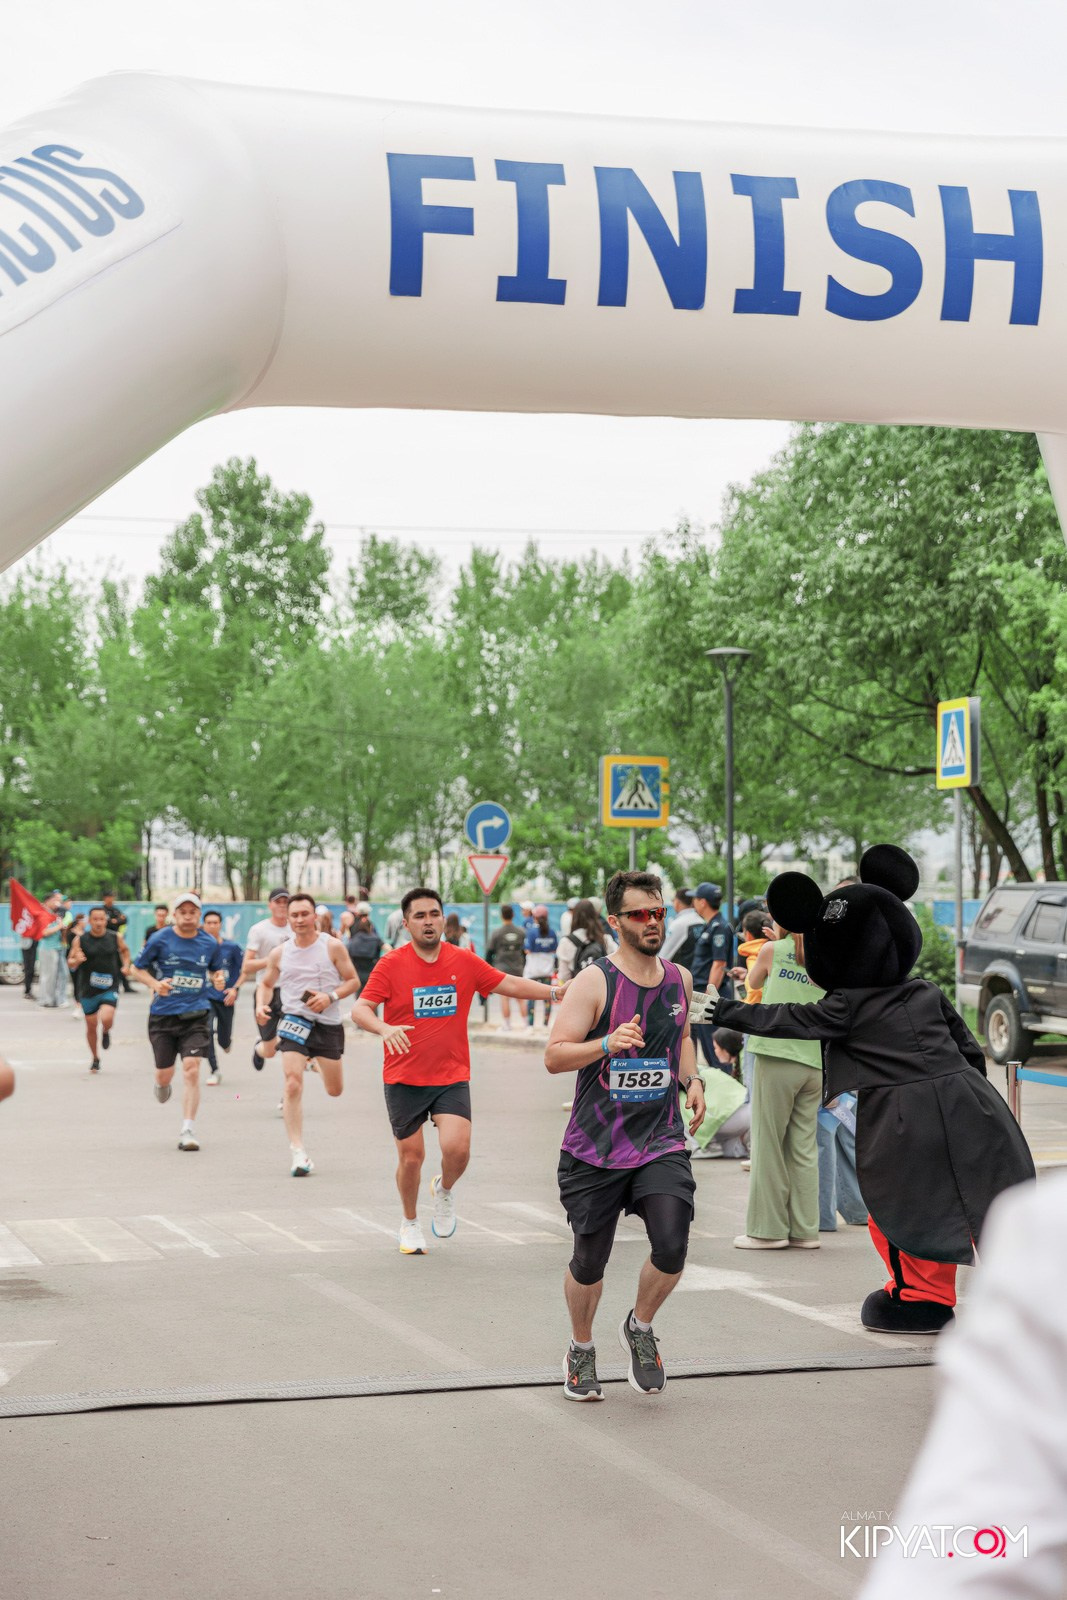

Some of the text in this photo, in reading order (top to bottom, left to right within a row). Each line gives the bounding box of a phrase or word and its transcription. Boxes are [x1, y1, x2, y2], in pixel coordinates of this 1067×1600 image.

[386, 152, 1044, 326] FINISH
[779, 968, 812, 986] ВОЛО
[419, 994, 453, 1008] 1464
[283, 1022, 304, 1035] 1141
[618, 1071, 664, 1089] 1582
